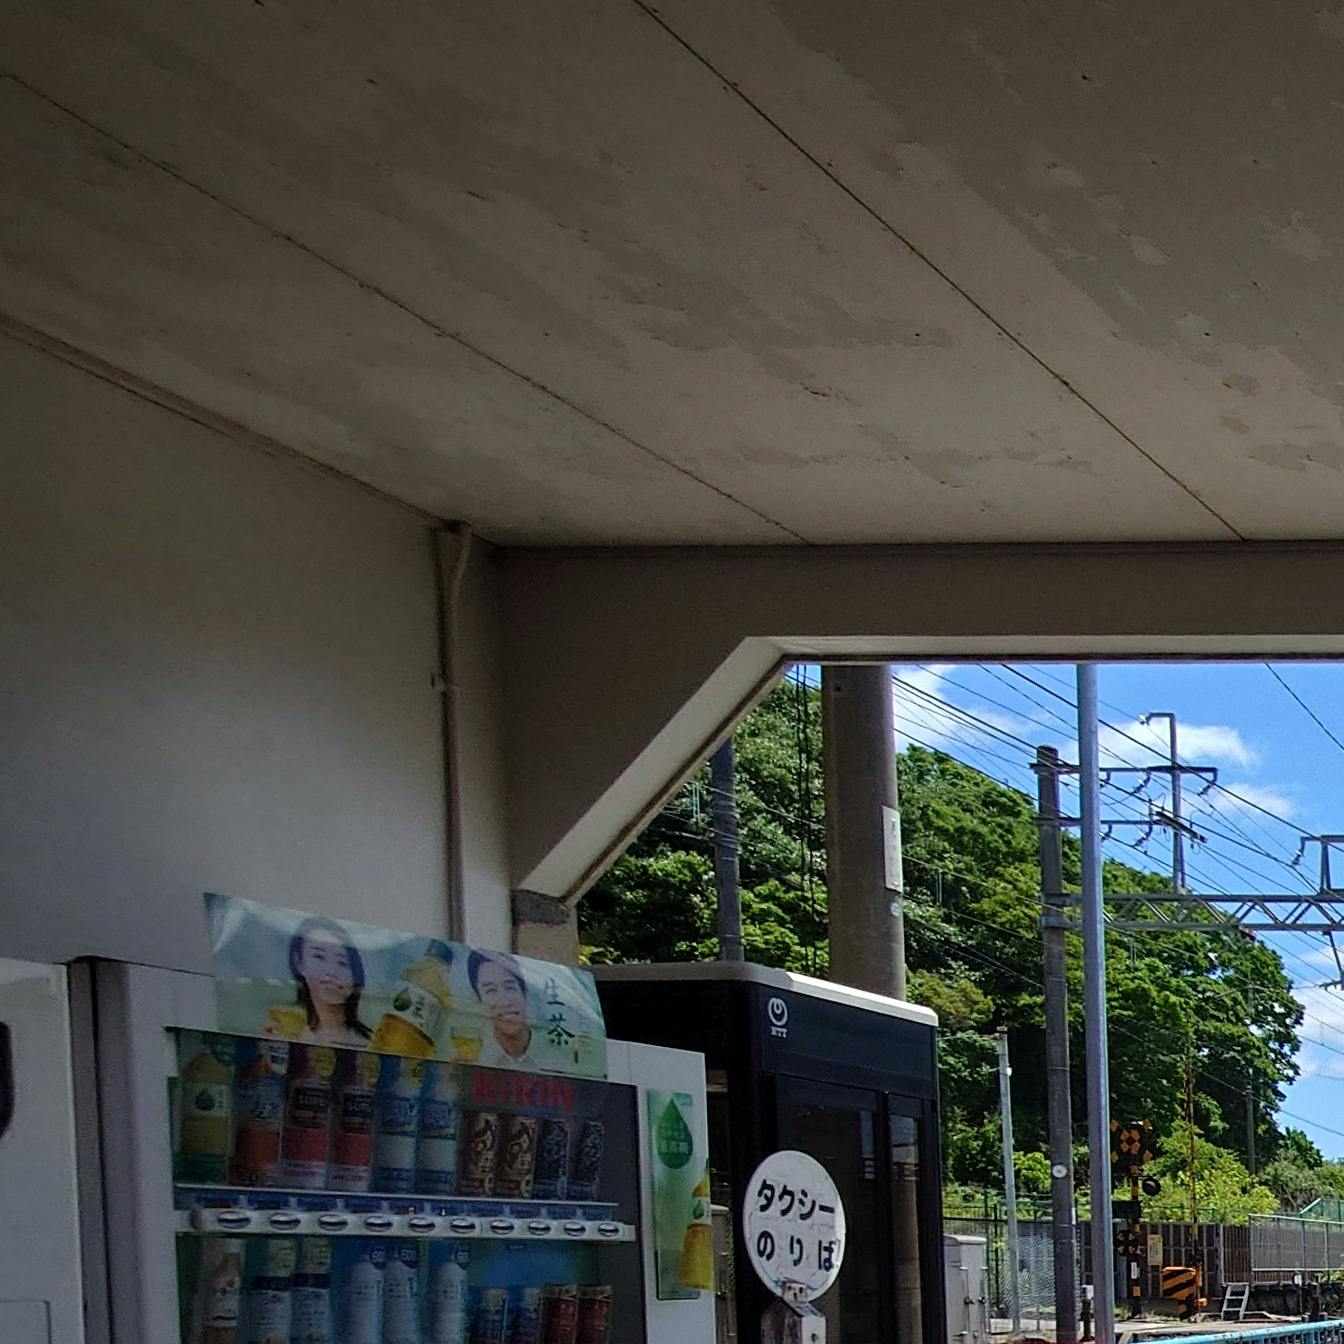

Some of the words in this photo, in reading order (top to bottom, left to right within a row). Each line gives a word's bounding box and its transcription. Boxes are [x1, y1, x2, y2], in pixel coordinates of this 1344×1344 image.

[544, 977, 575, 1046] 生茶
[473, 1068, 575, 1112] KIRIN
[757, 1178, 836, 1221] タクシー
